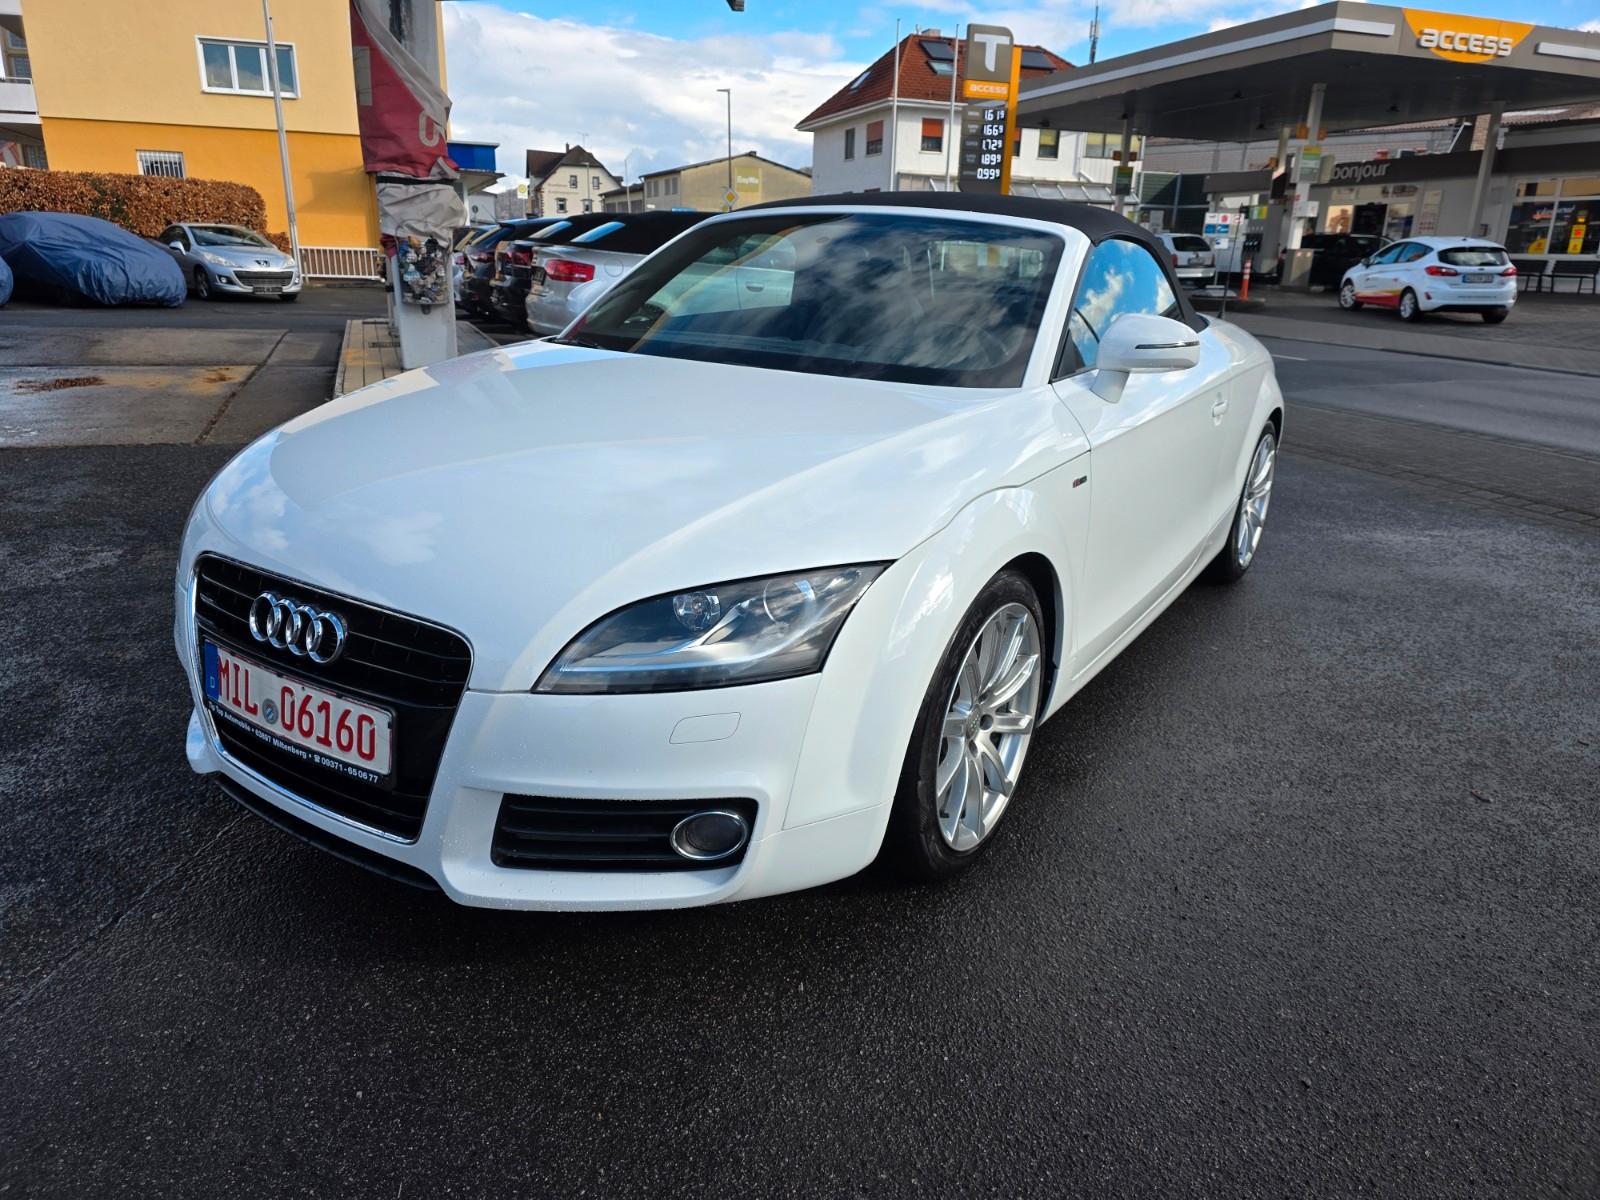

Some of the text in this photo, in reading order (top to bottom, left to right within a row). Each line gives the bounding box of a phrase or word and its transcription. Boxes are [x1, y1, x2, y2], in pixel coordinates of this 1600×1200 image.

[1420, 28, 1513, 57] access
[218, 654, 259, 717] MIL
[280, 685, 376, 762] 06160
